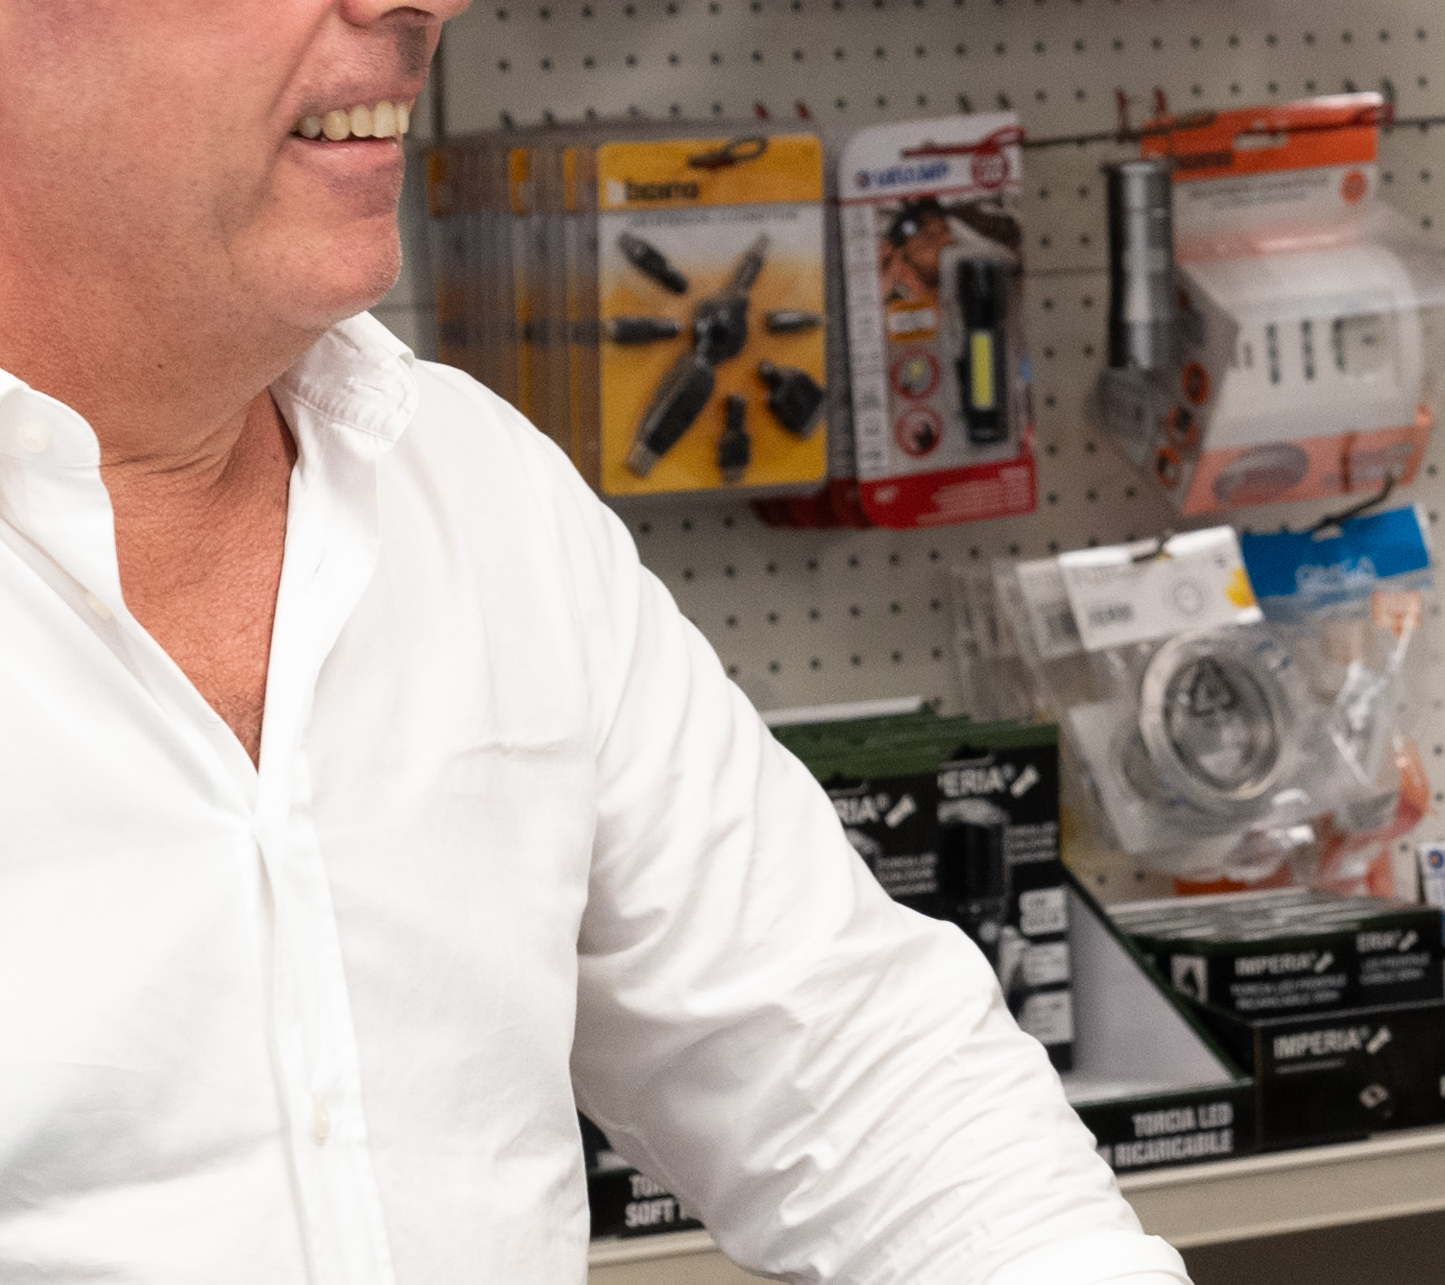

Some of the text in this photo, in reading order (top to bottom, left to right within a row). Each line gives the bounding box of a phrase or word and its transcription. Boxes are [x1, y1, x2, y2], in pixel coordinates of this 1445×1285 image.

[1273, 1031, 1356, 1059] IMPERIA
[1132, 1102, 1234, 1137] TORCIA LED
[1114, 1128, 1234, 1167] RICARICABILE
[625, 1199, 674, 1227] SOFT
